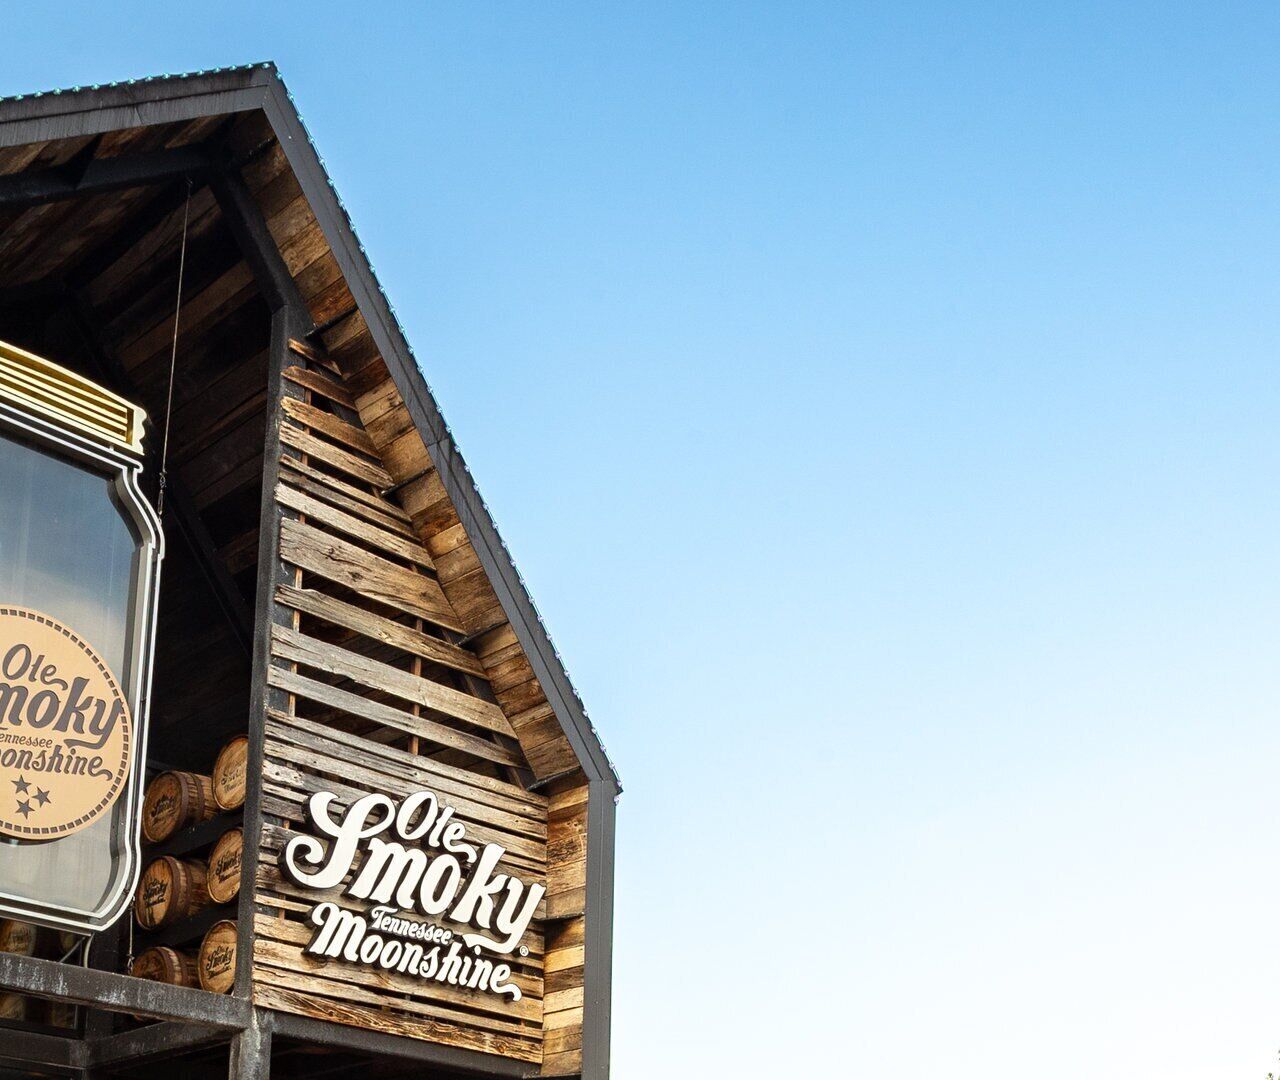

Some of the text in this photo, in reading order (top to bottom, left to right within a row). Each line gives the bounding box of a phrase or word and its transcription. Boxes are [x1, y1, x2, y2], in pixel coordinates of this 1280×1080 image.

[2, 643, 69, 691] Ole
[396, 790, 477, 864] Ole
[285, 791, 547, 954] Smoky
[307, 901, 522, 1002] Moonshine
[371, 905, 454, 946] Tennessee
